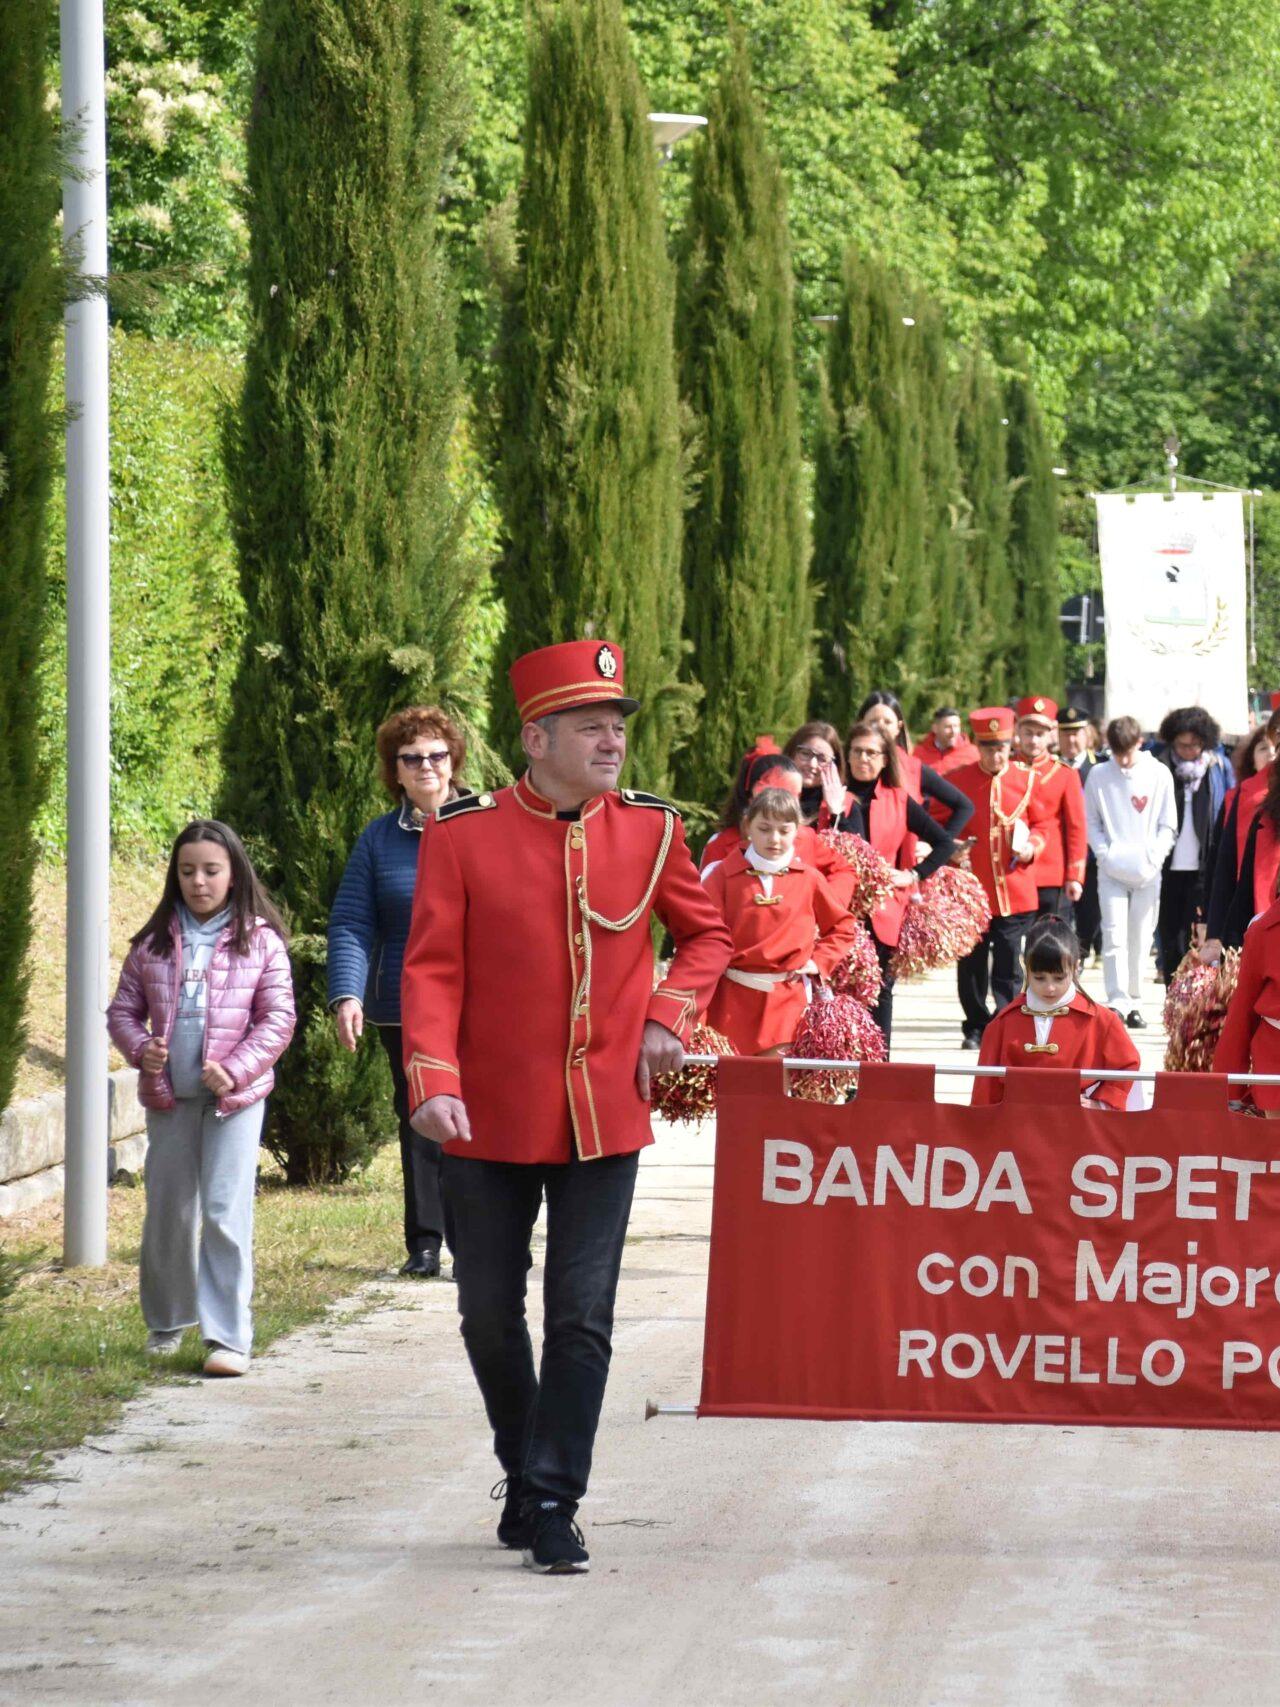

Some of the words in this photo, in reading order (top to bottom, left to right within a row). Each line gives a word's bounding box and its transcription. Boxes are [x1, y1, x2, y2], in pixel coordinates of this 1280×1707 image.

[763, 1140, 1033, 1214] BANDA
[918, 1253, 1039, 1299] con
[898, 1330, 1186, 1387] ROVELLO
